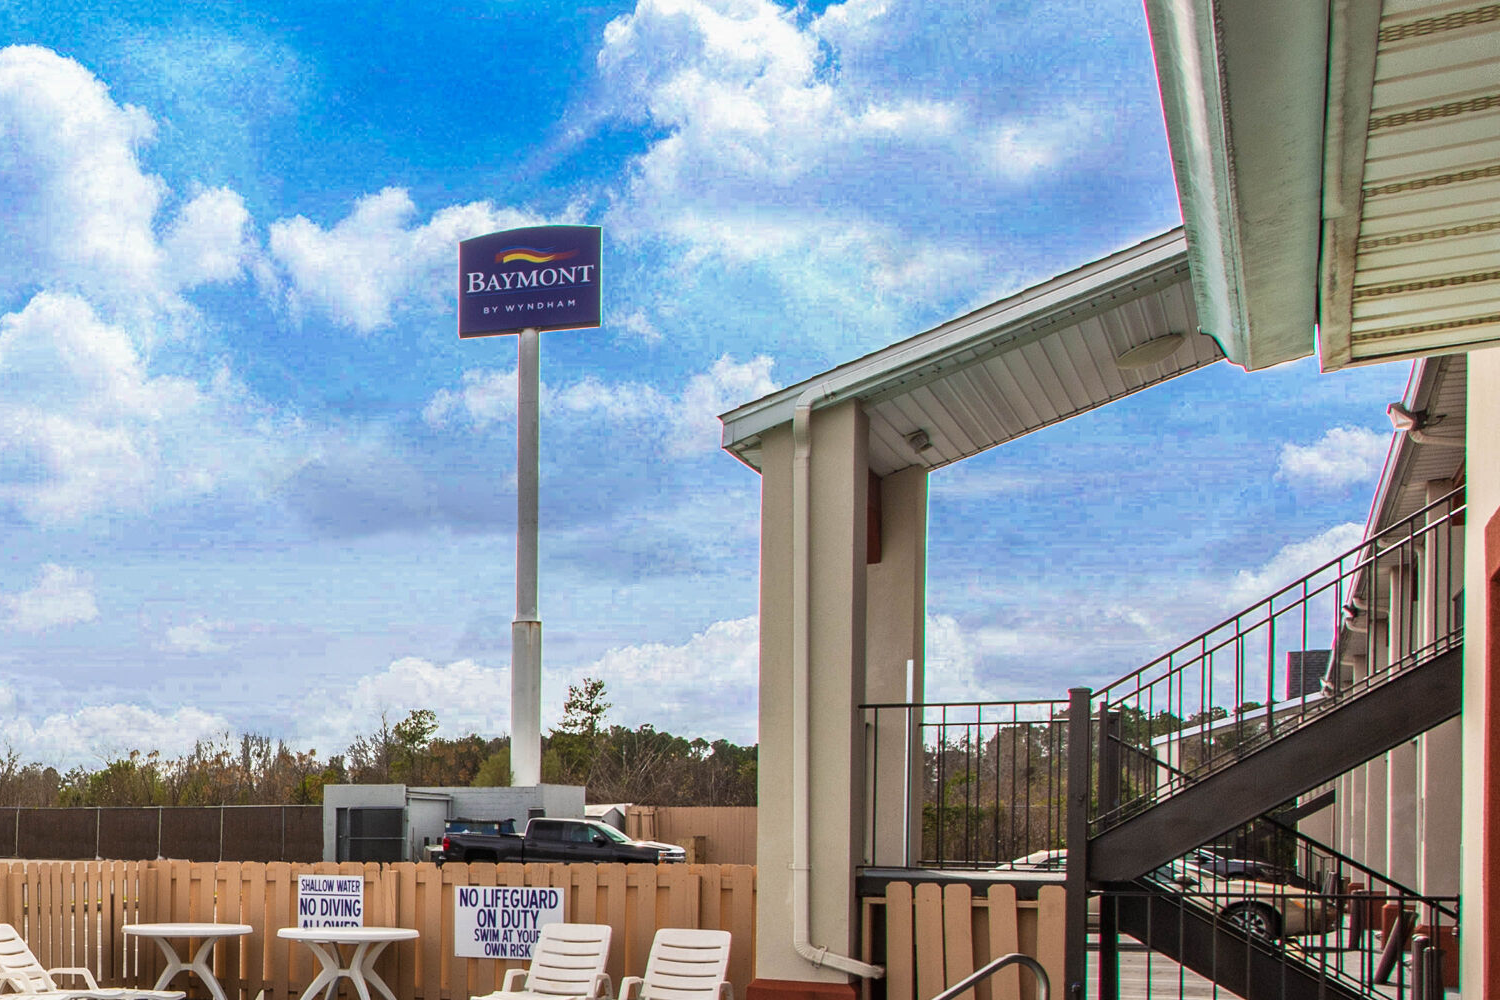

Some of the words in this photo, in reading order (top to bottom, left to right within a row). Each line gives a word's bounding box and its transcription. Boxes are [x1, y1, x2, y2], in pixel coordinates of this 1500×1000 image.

[466, 264, 595, 293] BAYMONT
[483, 306, 499, 314] BY
[505, 299, 576, 312] WYNDHAM
[301, 879, 335, 892] SHALLOW
[336, 880, 360, 893] WATER
[460, 888, 479, 907] NO
[483, 889, 558, 909] LIFEGUARD
[300, 898, 317, 916] NO
[320, 898, 361, 917] DIVING
[477, 909, 496, 928] ON
[501, 910, 539, 929] DUTY
[474, 928, 499, 942] SWIM
[502, 930, 513, 942] AT
[484, 943, 507, 956] OWN
[510, 944, 531, 957] RISK
